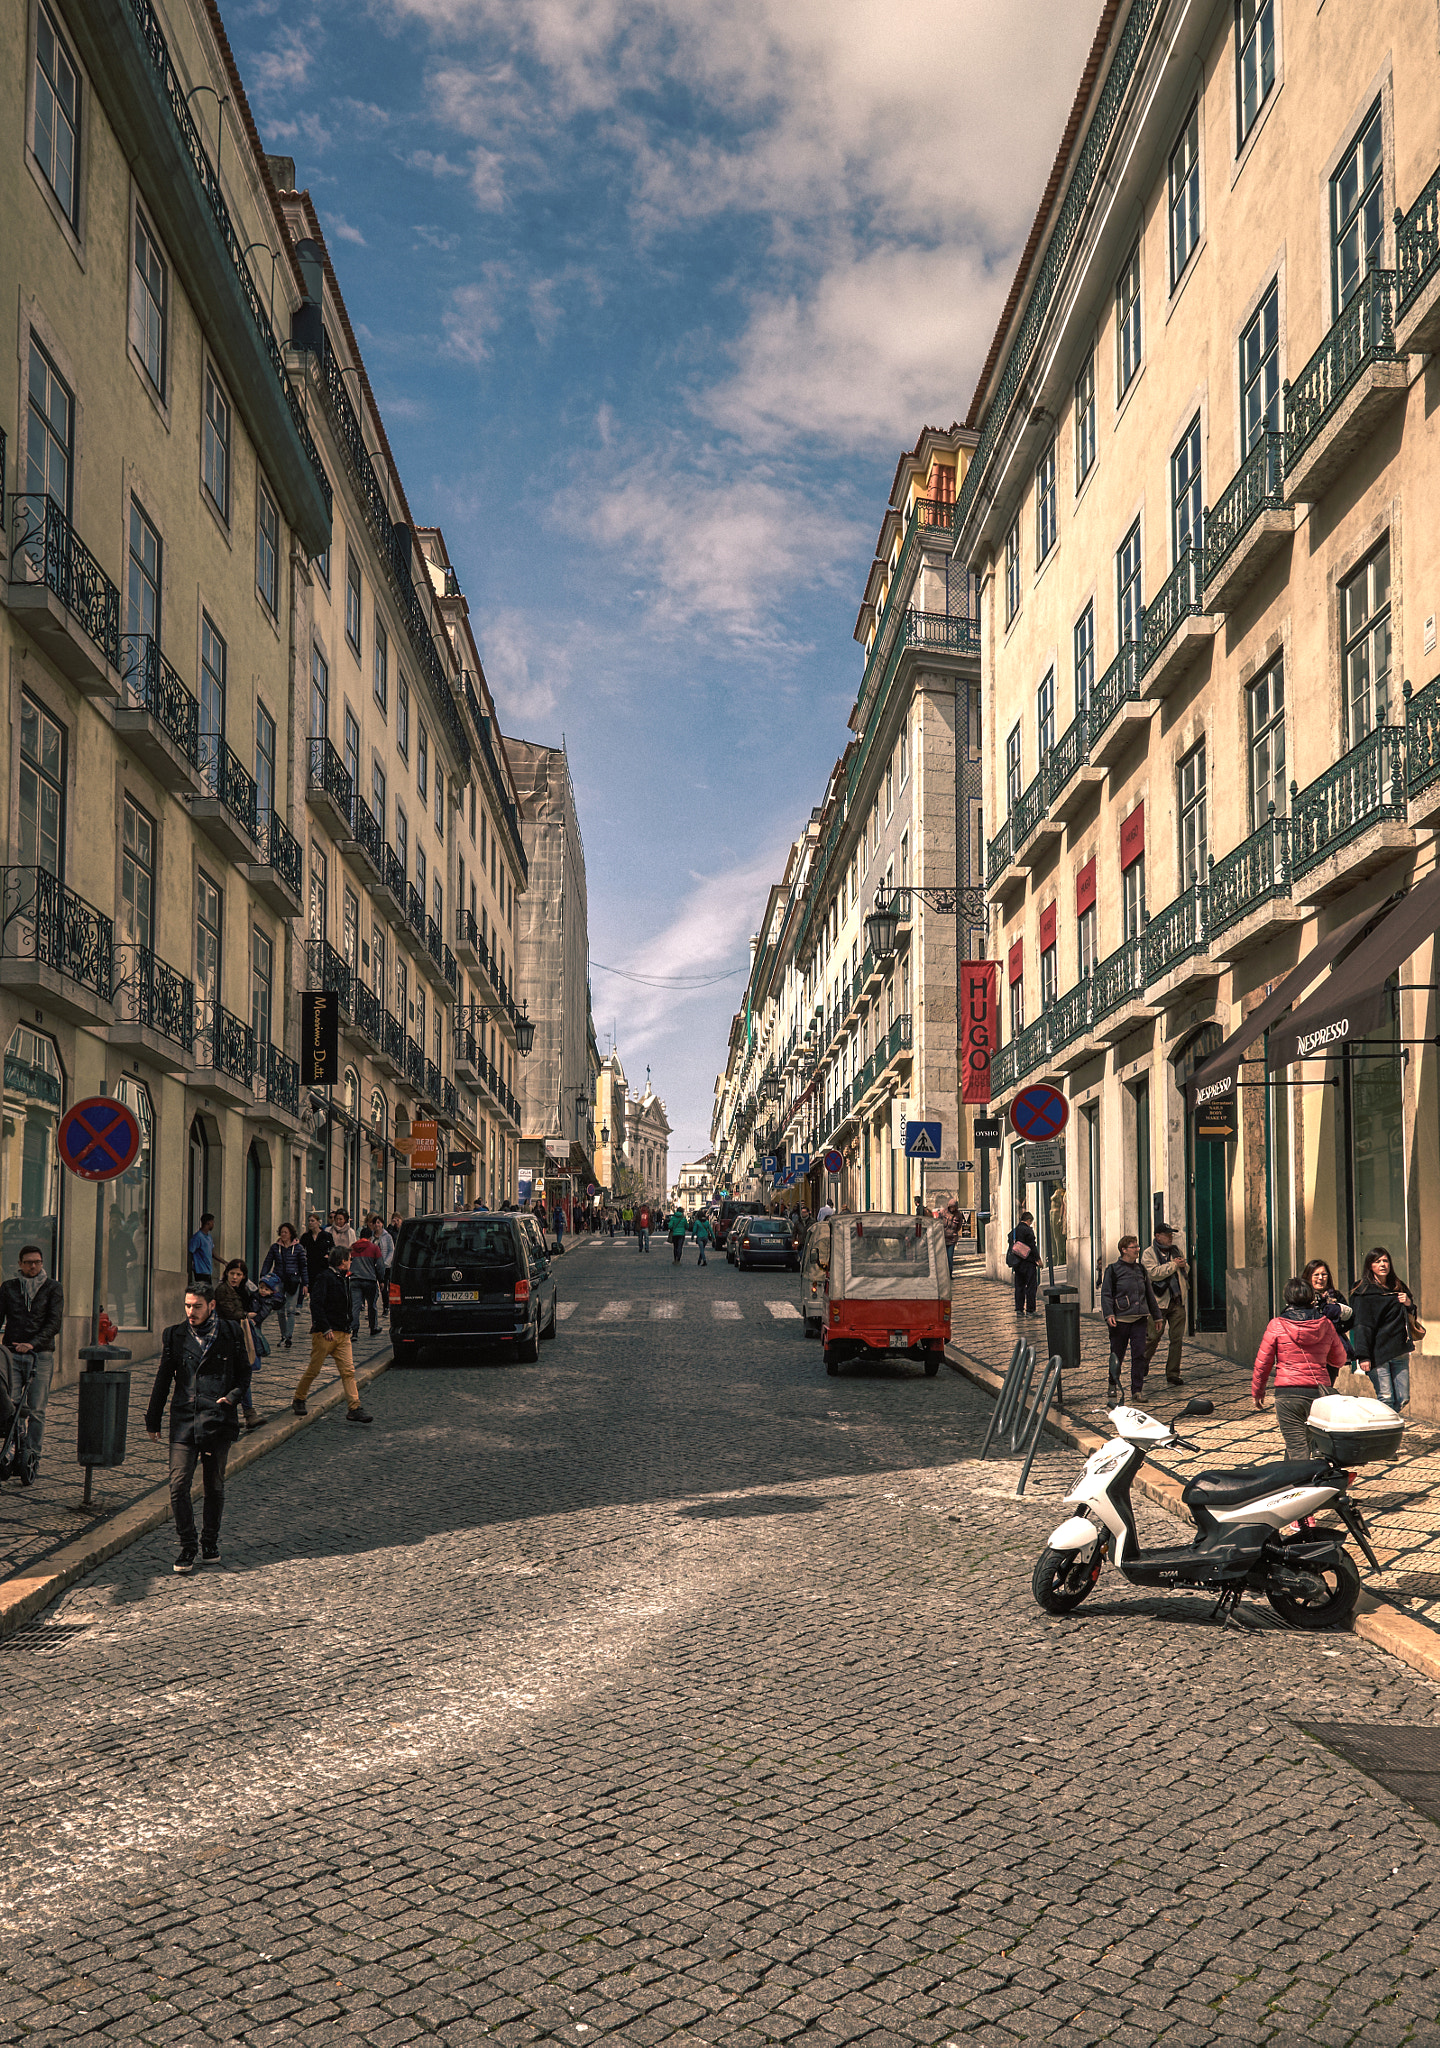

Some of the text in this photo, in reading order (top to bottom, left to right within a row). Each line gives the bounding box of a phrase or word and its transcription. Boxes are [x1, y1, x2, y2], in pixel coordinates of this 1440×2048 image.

[313, 996, 327, 1080] Massimo Dutti
[969, 978, 990, 1071] HUGO
[1296, 1018, 1349, 1056] NESPRESSO
[1195, 1076, 1232, 1105] NESPRESSO
[1158, 1570, 1179, 1578] SYM
